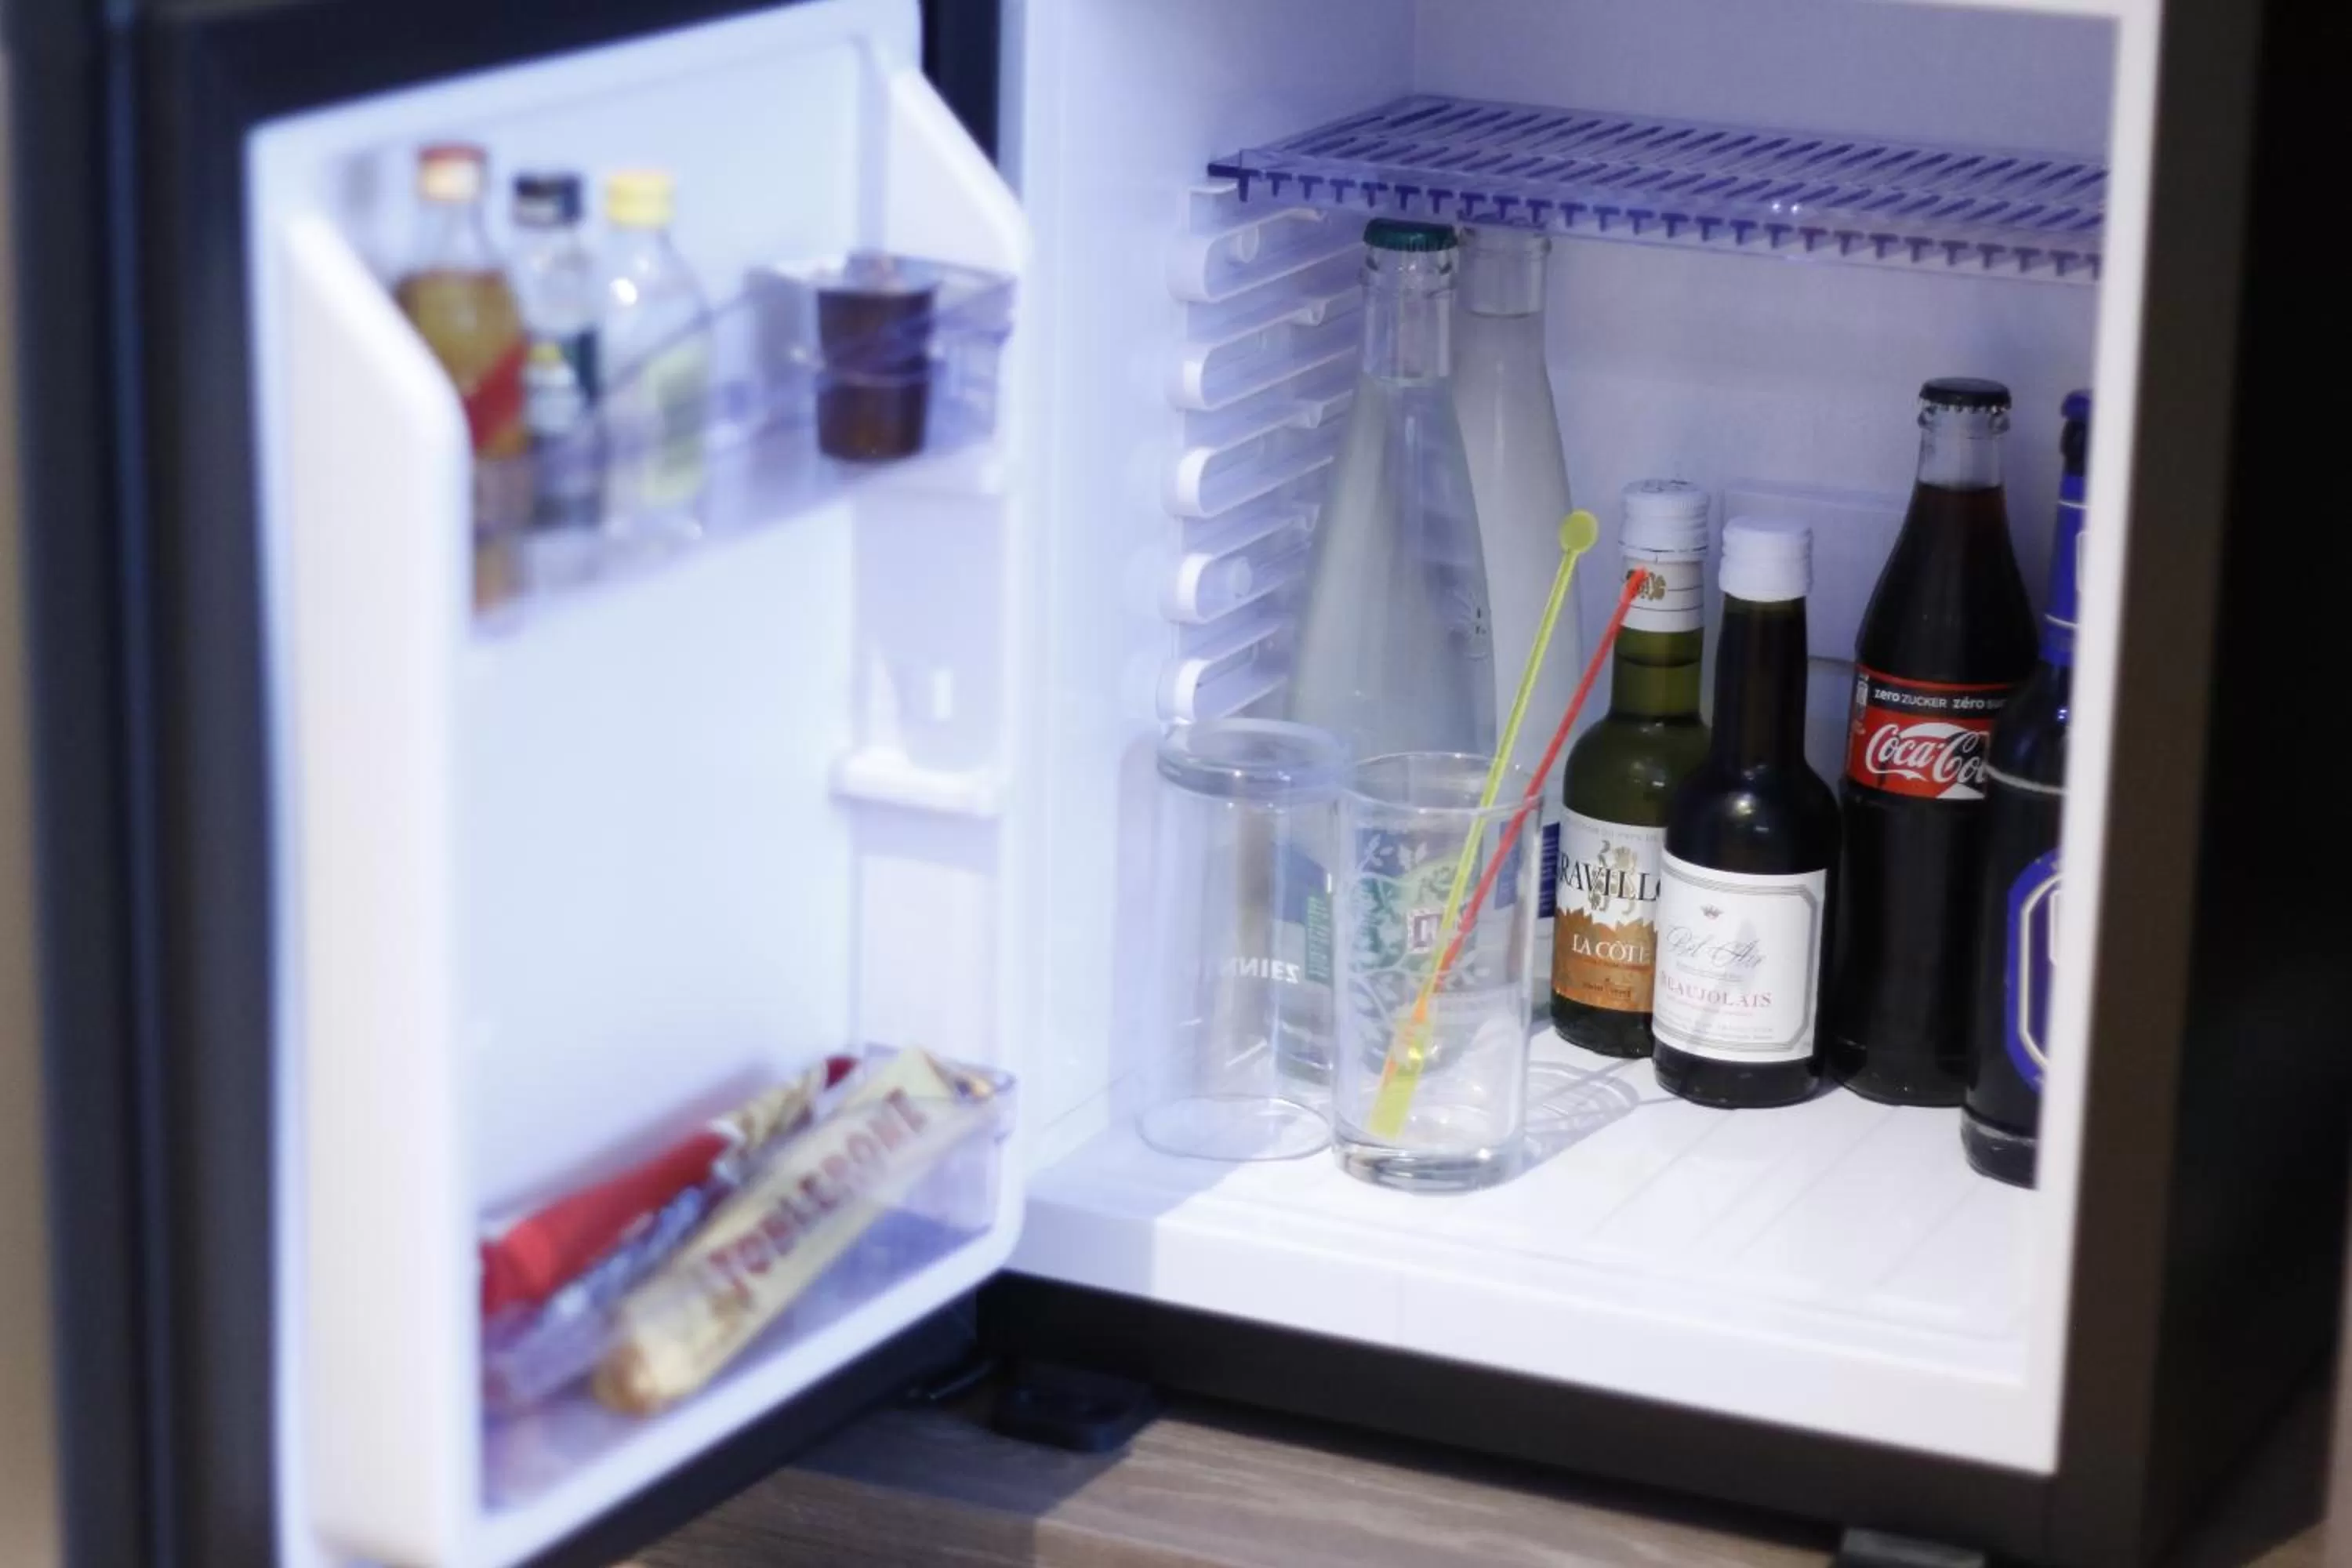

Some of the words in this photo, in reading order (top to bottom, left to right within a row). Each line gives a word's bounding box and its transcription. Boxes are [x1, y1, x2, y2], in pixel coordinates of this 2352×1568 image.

[1900, 694, 1947, 709] ZUCKER
[1557, 851, 1661, 902] RAVILL
[1571, 933, 1592, 956] LA
[704, 1085, 928, 1308] TOBLERONE
